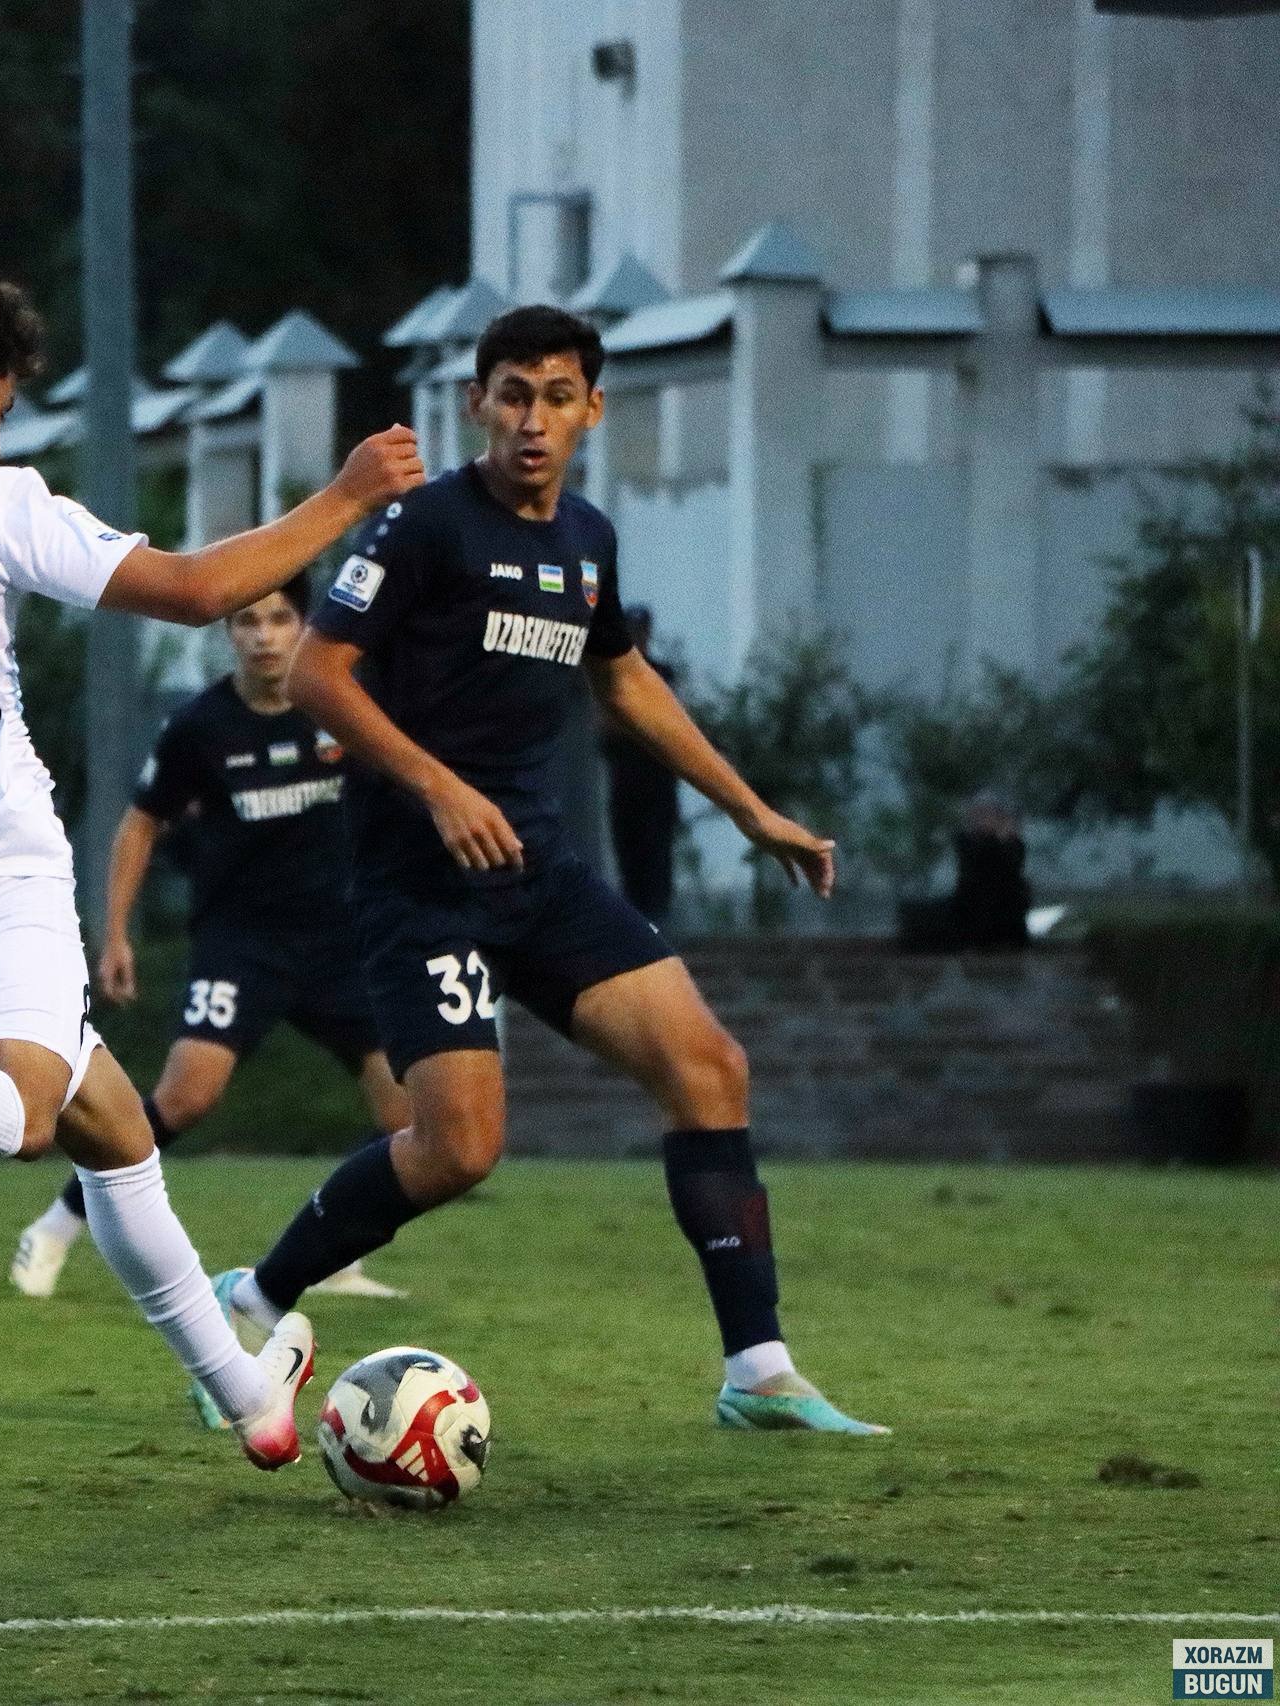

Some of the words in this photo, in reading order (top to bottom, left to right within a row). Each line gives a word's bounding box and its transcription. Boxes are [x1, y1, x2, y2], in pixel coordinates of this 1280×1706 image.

[490, 562, 524, 580] JAKO
[183, 979, 238, 1029] 35
[425, 950, 496, 1026] 32
